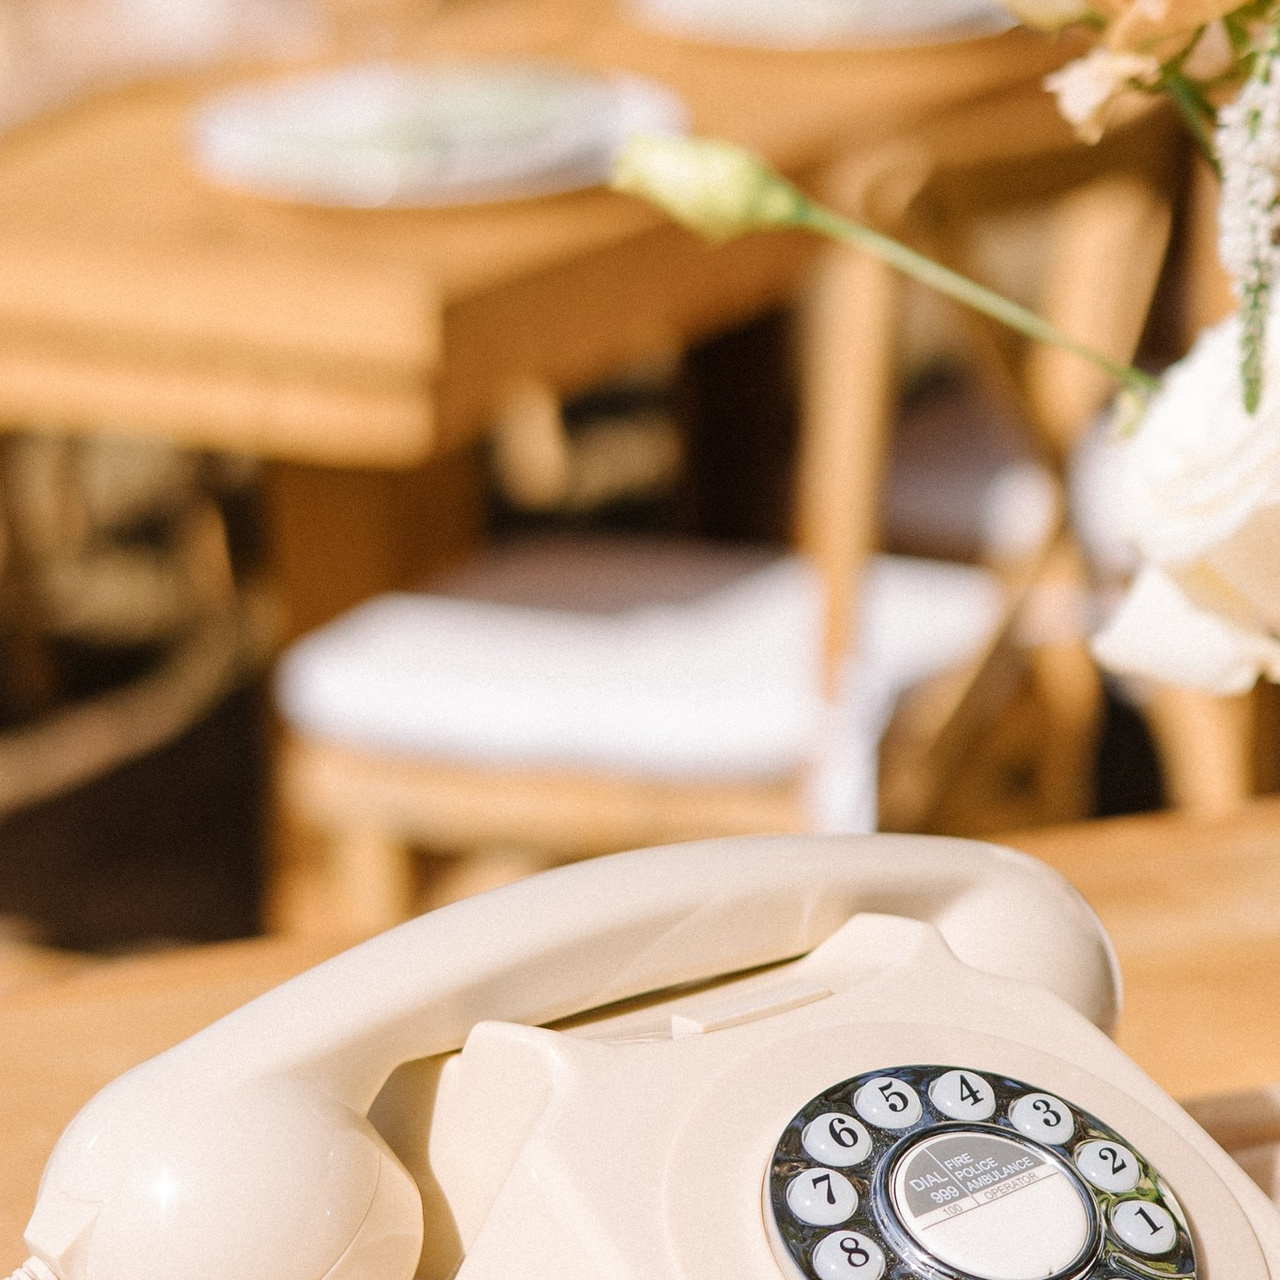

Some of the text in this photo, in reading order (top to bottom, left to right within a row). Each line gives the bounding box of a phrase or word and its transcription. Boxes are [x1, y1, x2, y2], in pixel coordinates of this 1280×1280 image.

[878, 1081, 909, 1112] 5
[956, 1074, 984, 1106] 4
[1032, 1099, 1061, 1126] 3
[829, 1117, 858, 1147] 6
[944, 1153, 974, 1170] FIRE
[954, 1157, 998, 1181] POLICE
[966, 1156, 1034, 1192] AMBULANCE
[1098, 1147, 1127, 1175] 2
[812, 1174, 836, 1205] 7
[909, 1171, 949, 1192] DIAL
[930, 1185, 959, 1204] 999
[943, 1171, 1039, 1217] 100 OPERATOR
[1135, 1207, 1164, 1235] 1
[839, 1237, 870, 1267] 8
